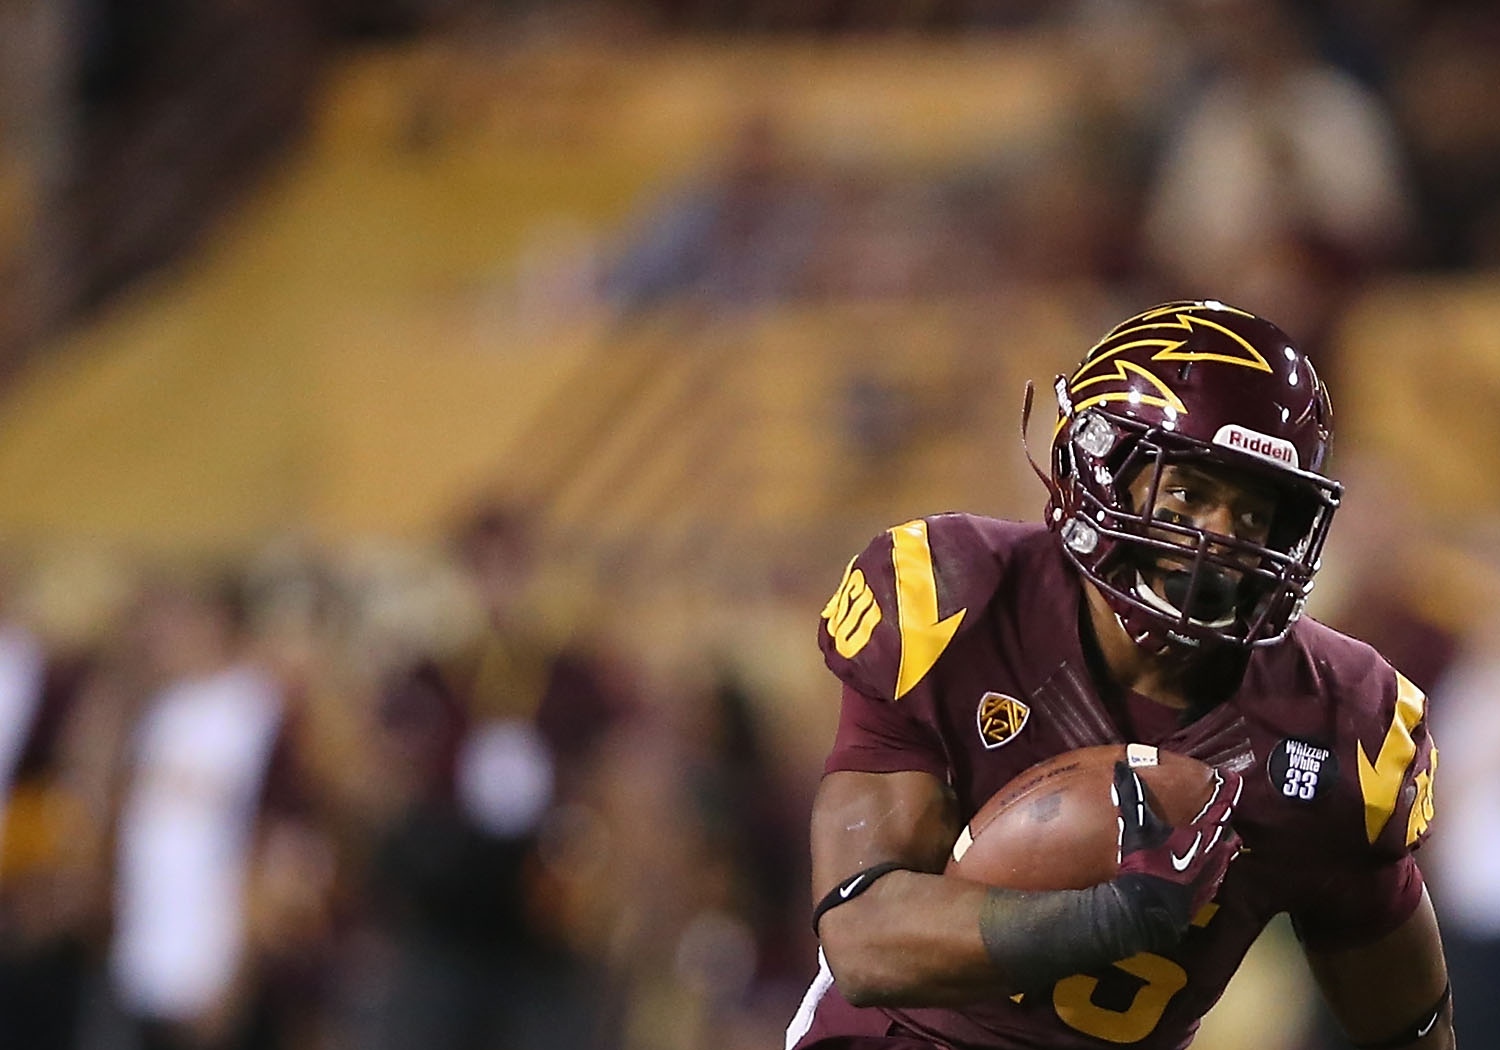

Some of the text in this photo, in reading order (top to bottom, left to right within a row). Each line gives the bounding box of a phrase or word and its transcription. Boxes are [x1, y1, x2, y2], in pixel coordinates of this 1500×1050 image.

[1228, 429, 1293, 463] Riddell
[981, 697, 1027, 734] PAC
[983, 717, 1009, 741] 12
[1286, 739, 1330, 762] Whizzer
[1289, 753, 1321, 773] White
[1283, 768, 1318, 800] 33
